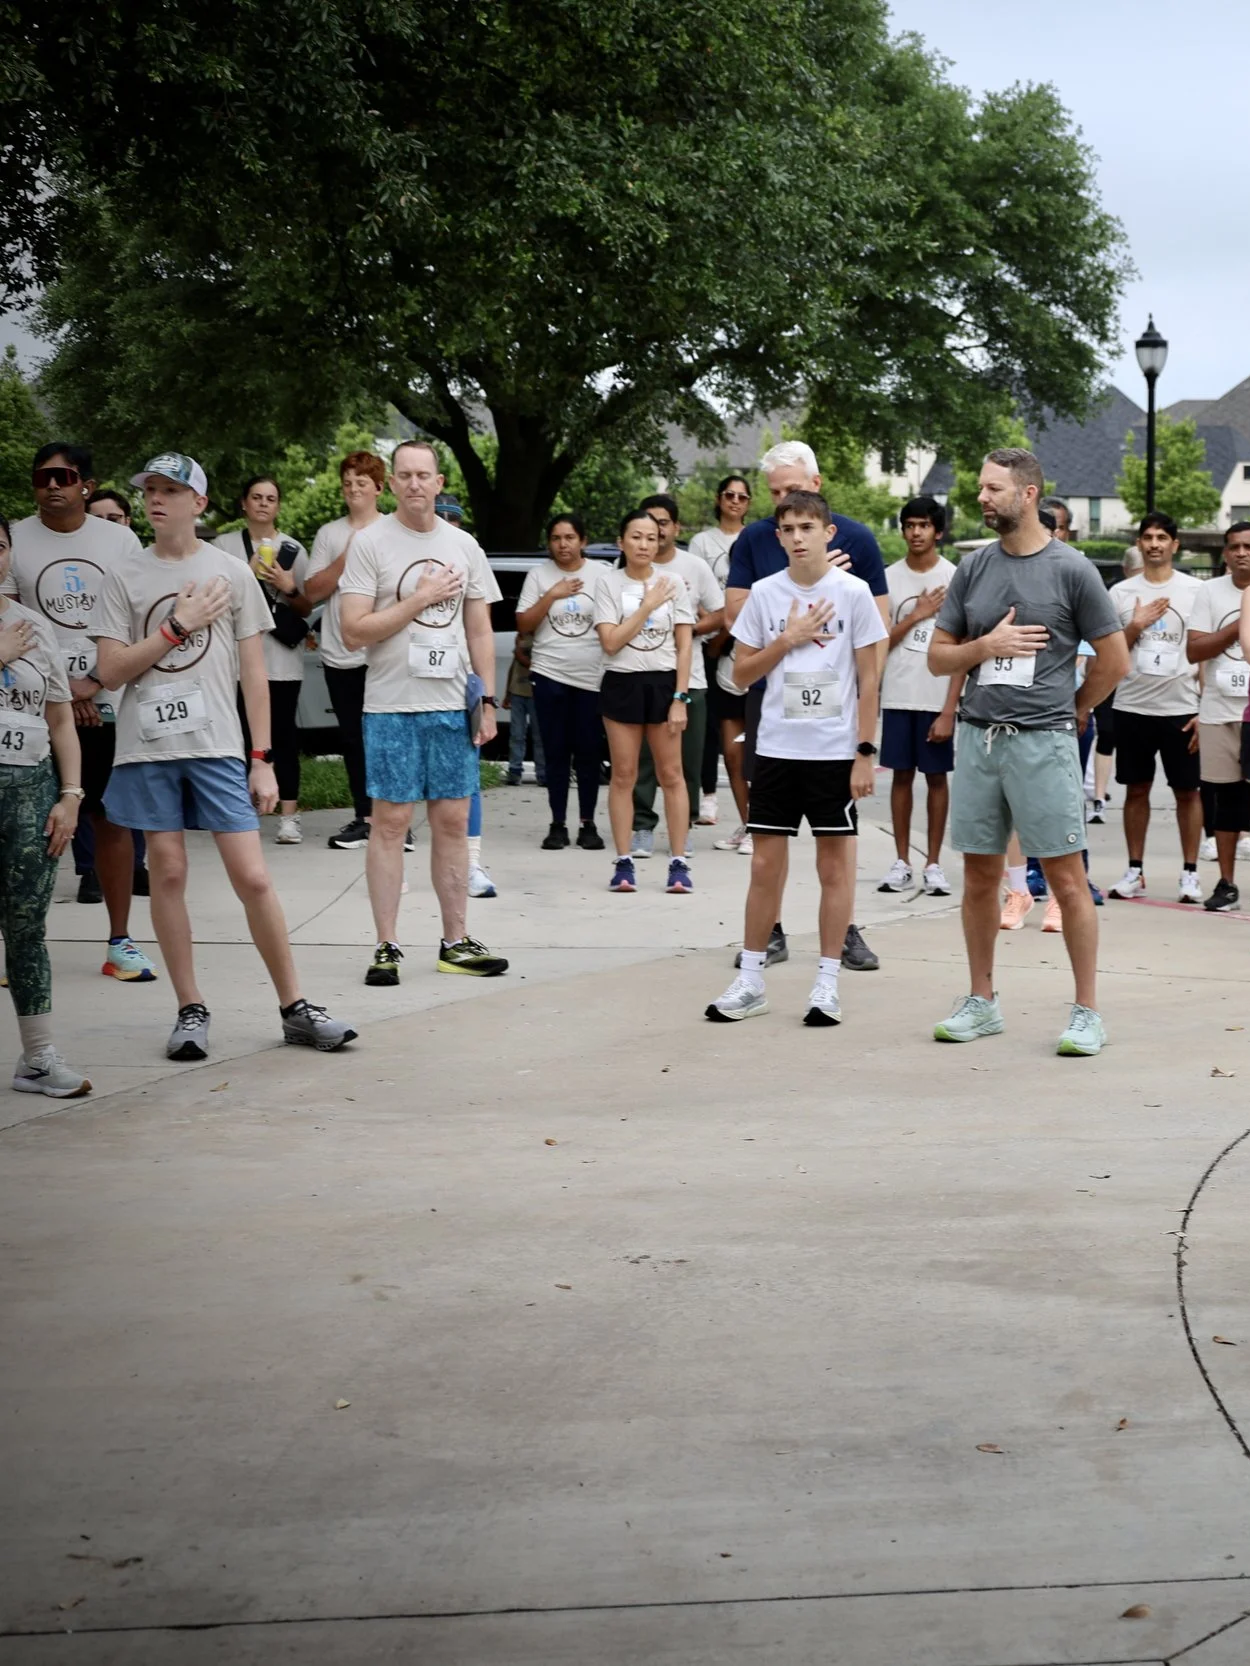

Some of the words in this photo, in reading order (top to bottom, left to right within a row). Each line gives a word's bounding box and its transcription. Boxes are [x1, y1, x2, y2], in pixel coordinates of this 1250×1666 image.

[45, 593, 97, 613] MUSTAN
[769, 618, 844, 634] JOAN
[913, 629, 927, 643] 68
[67, 655, 87, 672] 76
[428, 650, 446, 666] 87
[994, 656, 1014, 671] 93
[1153, 654, 1161, 666] 4
[1230, 674, 1246, 687] 99
[802, 688, 822, 706] 92
[155, 700, 188, 723] 129
[1, 730, 24, 751] 43
